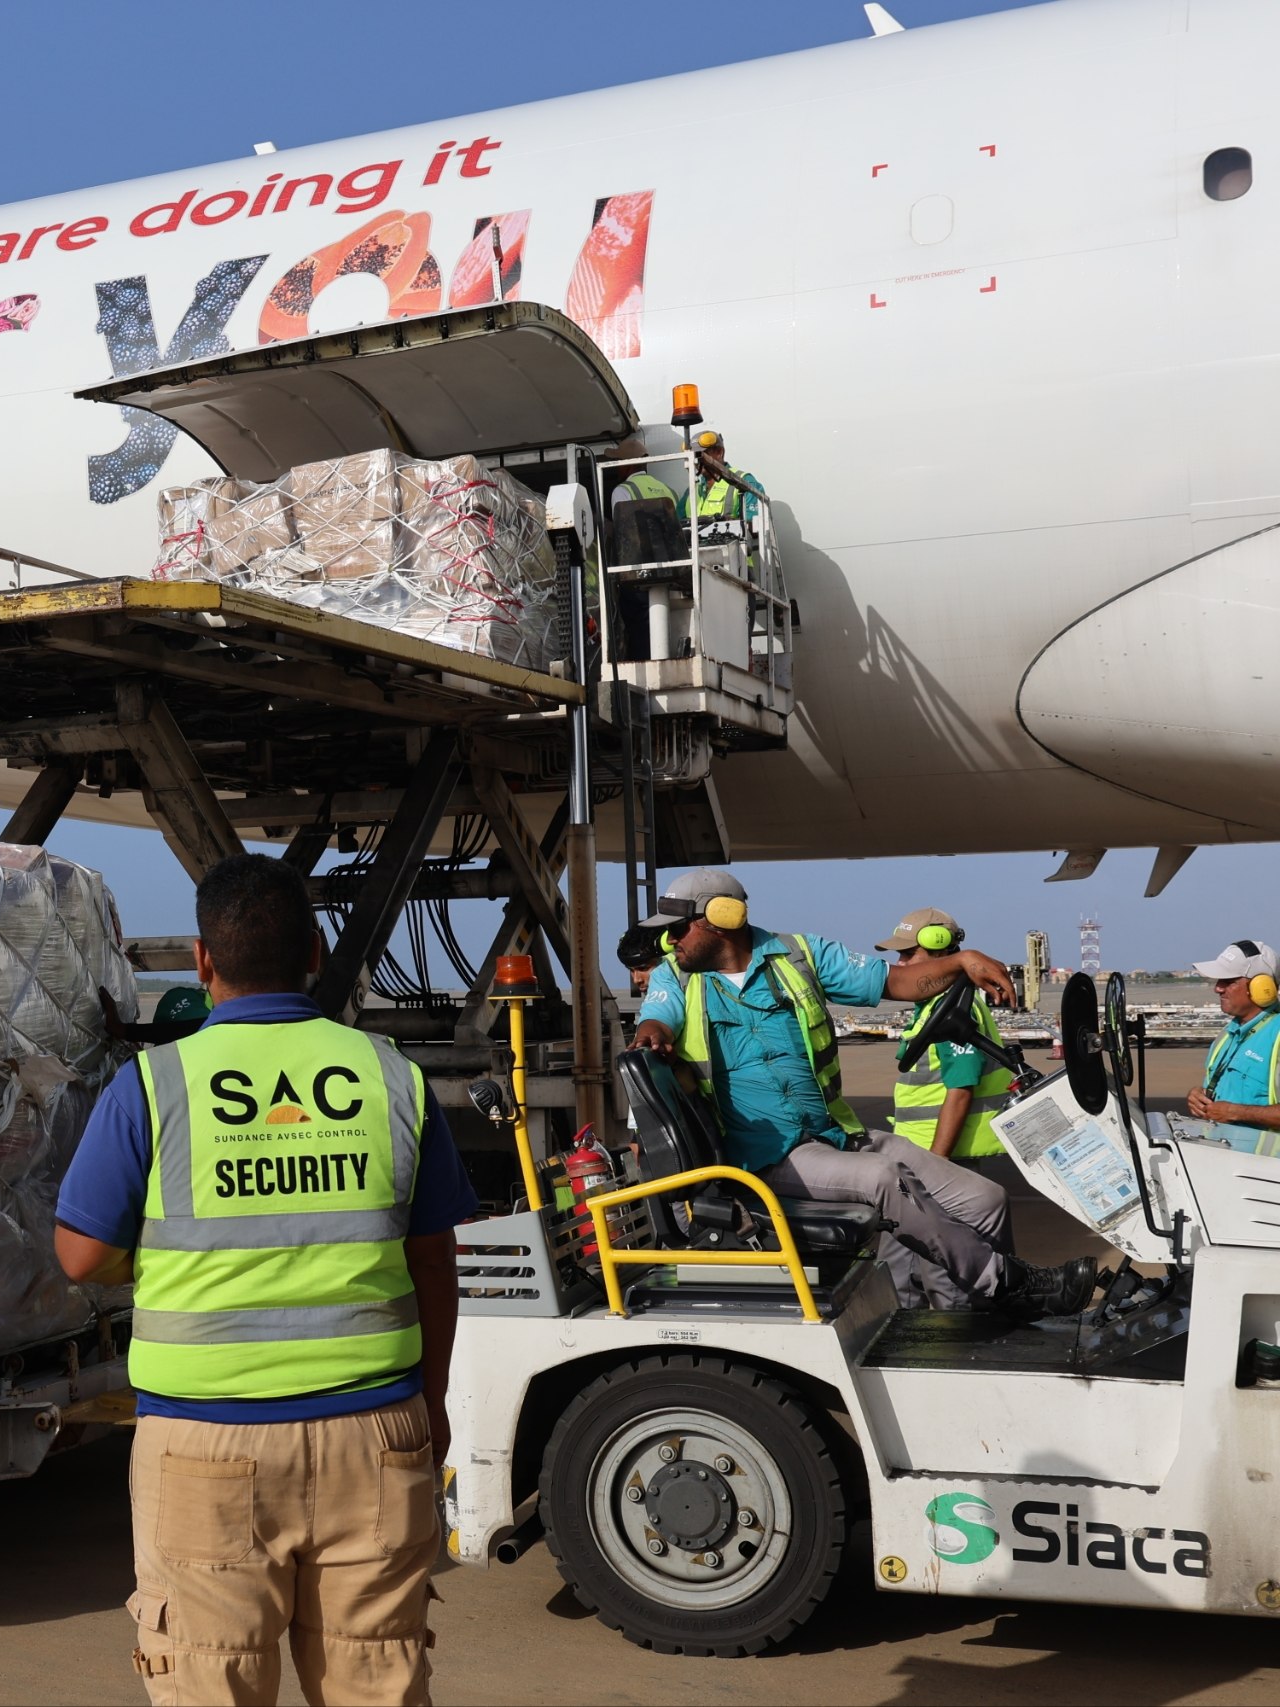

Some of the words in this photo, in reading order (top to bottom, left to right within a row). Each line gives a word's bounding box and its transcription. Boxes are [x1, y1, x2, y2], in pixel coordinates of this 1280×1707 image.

[128, 158, 404, 238] doing
[422, 136, 502, 188] it
[87, 188, 655, 504] you
[210, 1066, 363, 1125] SAC
[214, 1133, 273, 1143] SUNDANCE
[277, 1131, 313, 1140] AVSEC
[317, 1129, 368, 1138] CONTROL
[215, 1153, 369, 1198] SECURITY
[1012, 1500, 1212, 1578] Siaca
